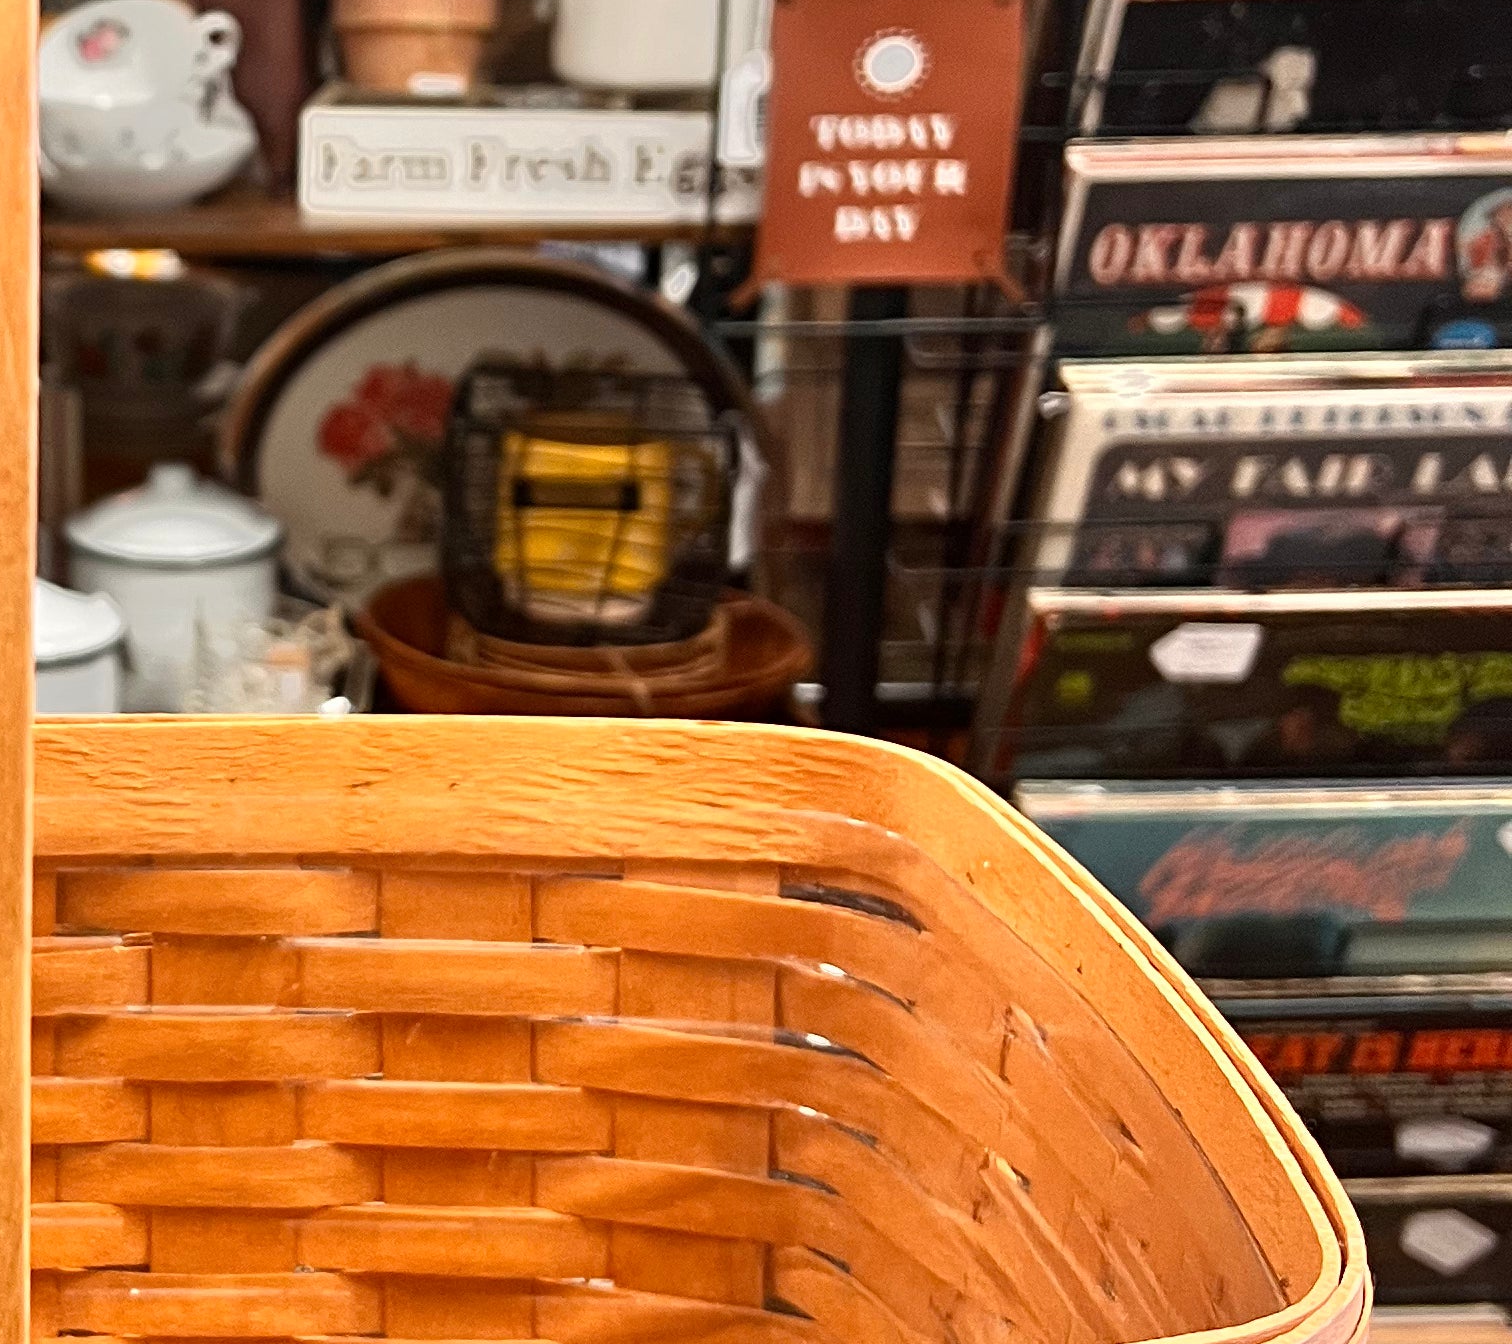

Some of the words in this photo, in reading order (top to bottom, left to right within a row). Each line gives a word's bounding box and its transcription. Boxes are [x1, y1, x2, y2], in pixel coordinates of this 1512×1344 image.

[809, 112, 959, 152] TODAY
[833, 204, 922, 244] DAY
[1090, 217, 1454, 285] OKLAHOMA
